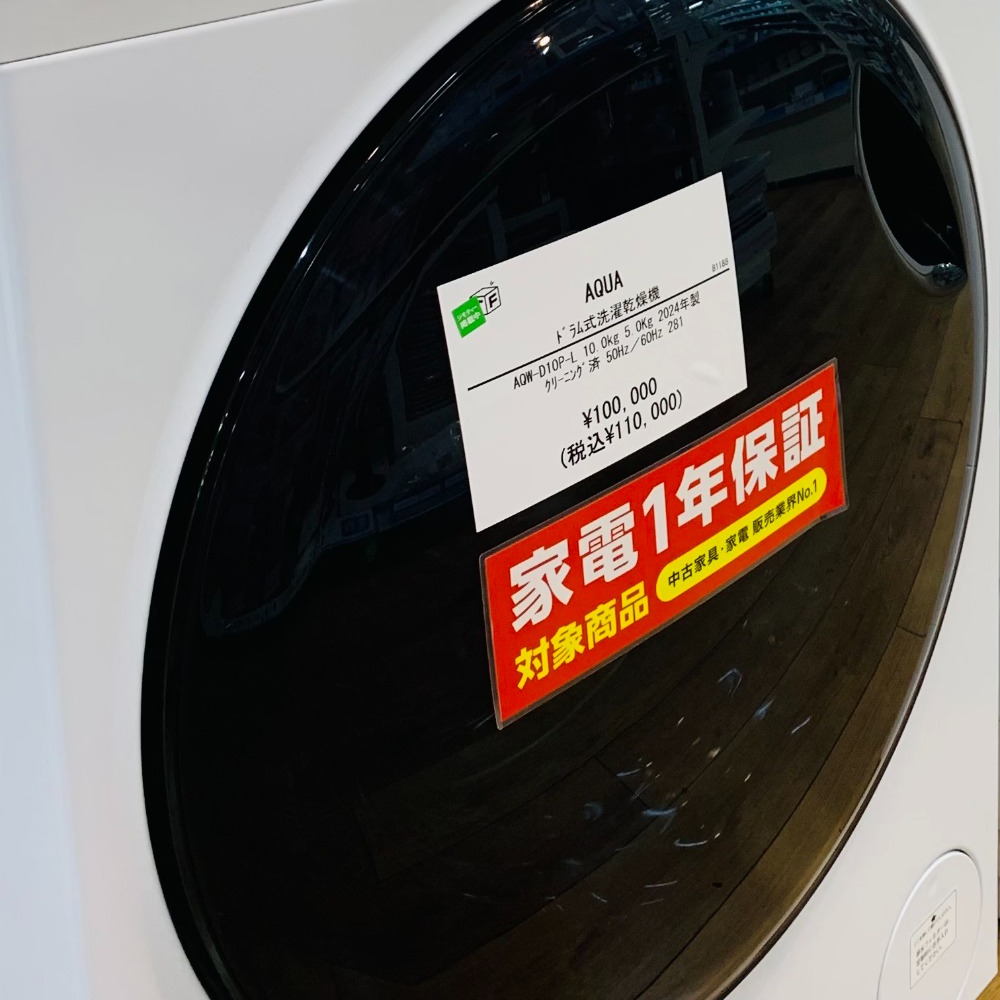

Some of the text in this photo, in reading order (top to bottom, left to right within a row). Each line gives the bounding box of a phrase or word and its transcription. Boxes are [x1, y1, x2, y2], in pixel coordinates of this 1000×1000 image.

[556, 286, 661, 344] ドラム式洗濯乾燥機
[585, 270, 624, 303] AQUA
[513, 352, 578, 389] AQW-D10P-L
[658, 291, 700, 322] 2024年製
[668, 317, 684, 334] 281
[560, 389, 683, 469] (税込¥110,000)
[582, 377, 658, 428] ¥100,000
[509, 388, 826, 632] 家電1年保証
[752, 479, 817, 536] 販売業界No.1
[515, 580, 649, 690] 対象商品
